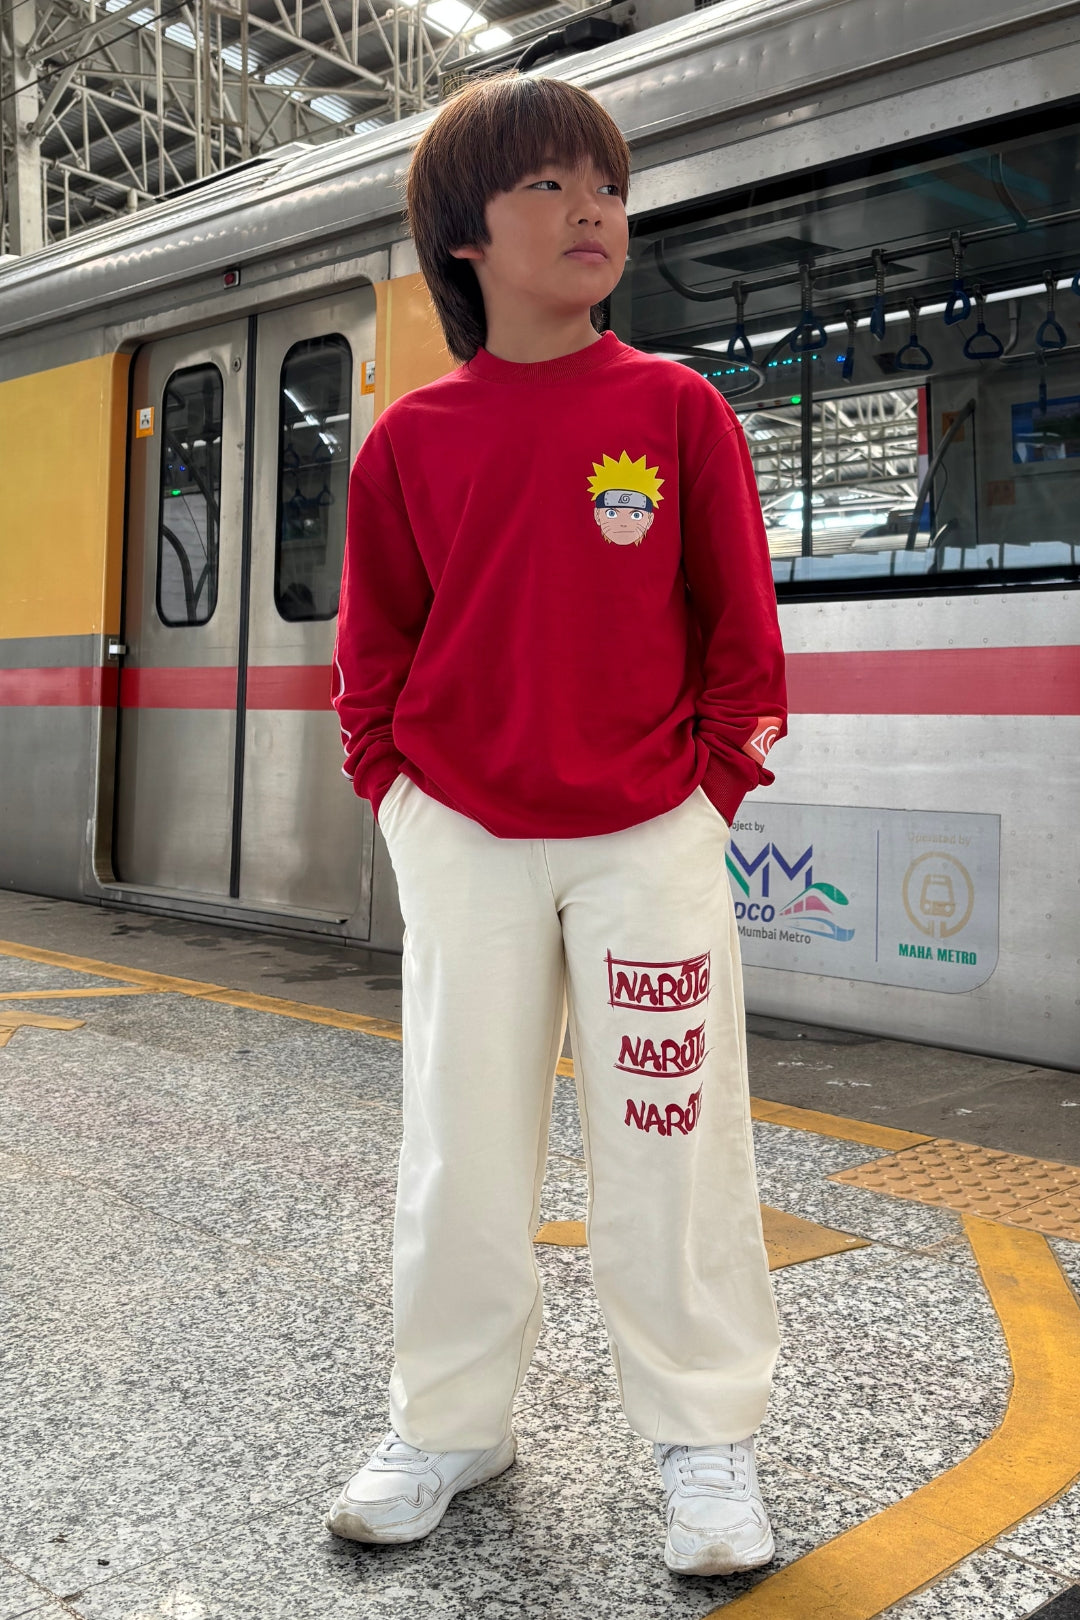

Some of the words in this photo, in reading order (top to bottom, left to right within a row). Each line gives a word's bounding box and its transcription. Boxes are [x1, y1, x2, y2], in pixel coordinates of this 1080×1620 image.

[732, 821, 753, 832] oject
[754, 821, 765, 833] by
[734, 901, 775, 923] DCO
[737, 925, 777, 940] Mumbai
[779, 930, 812, 944] Metro
[898, 943, 934, 960] MAHA
[937, 948, 977, 966] METRO
[614, 955, 708, 1006] NARUTO
